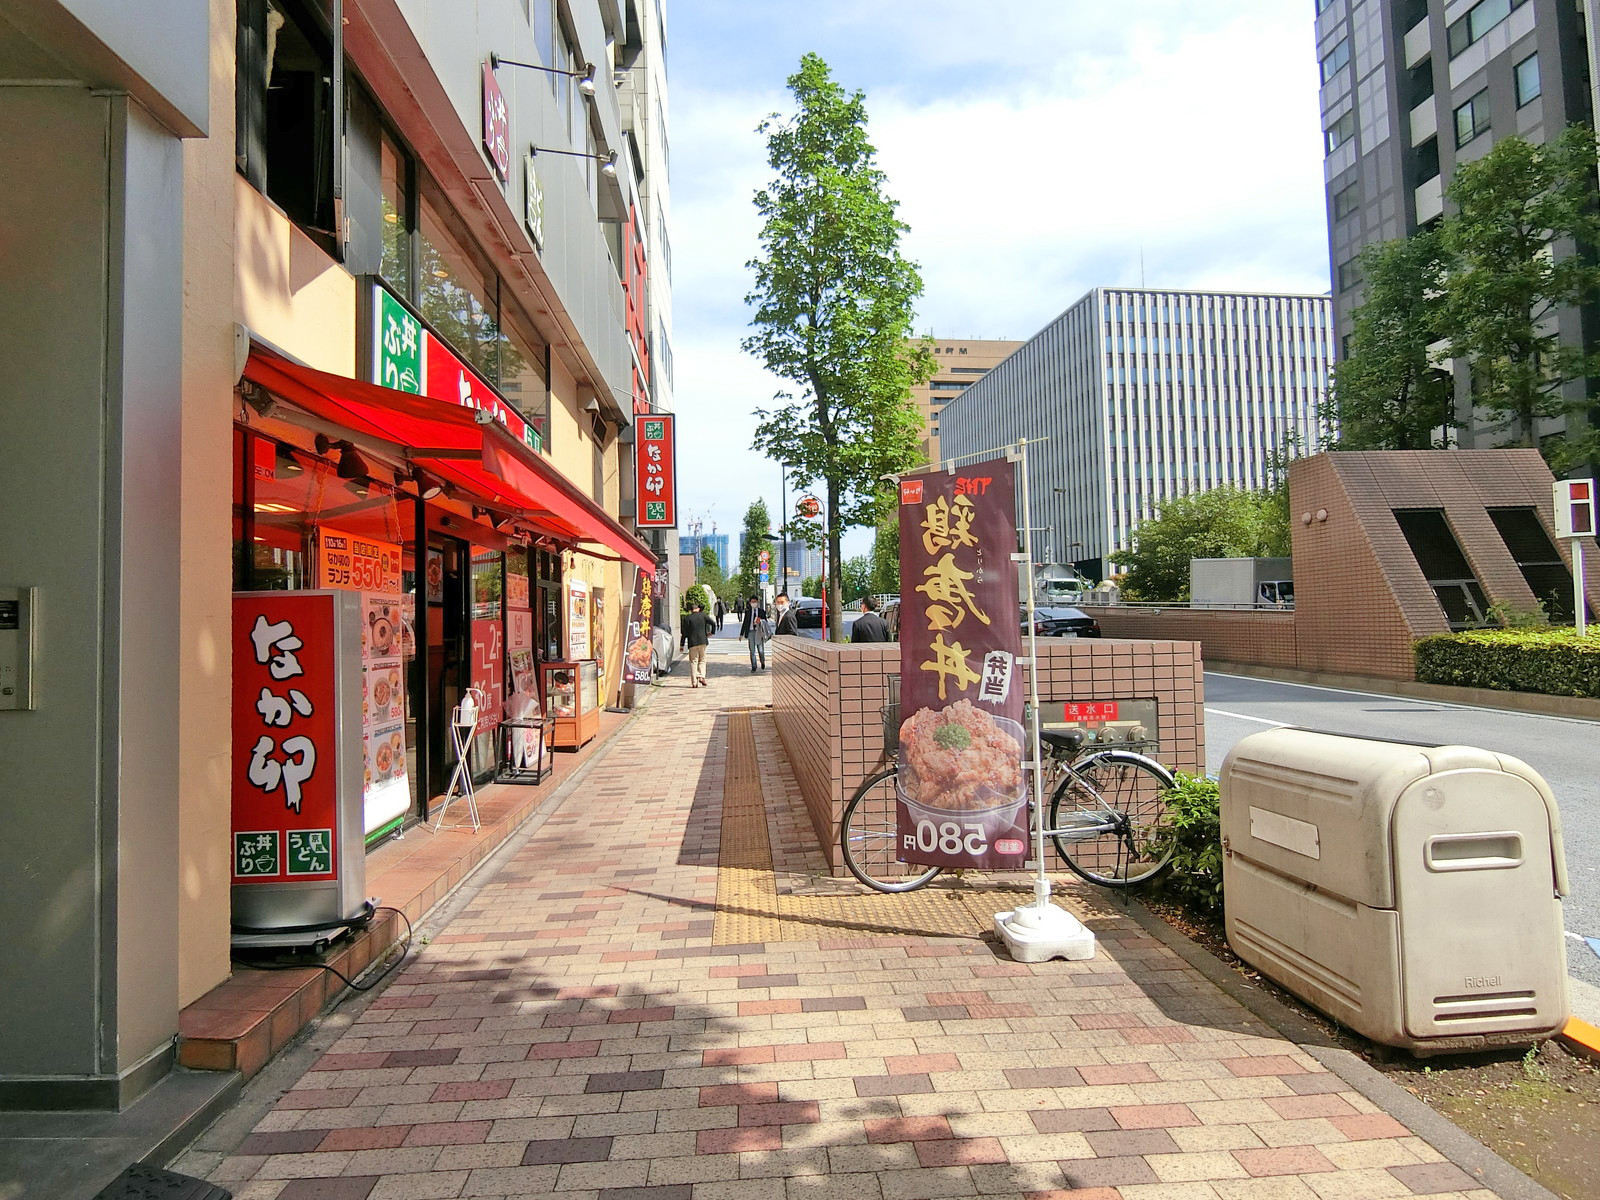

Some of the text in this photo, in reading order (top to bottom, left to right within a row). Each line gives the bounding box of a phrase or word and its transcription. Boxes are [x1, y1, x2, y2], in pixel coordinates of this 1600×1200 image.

[645, 444, 664, 497] なか卯
[327, 568, 350, 585] ランチ
[248, 614, 317, 814] なか卯
[1068, 703, 1114, 715] 送水口
[240, 834, 273, 873] 丼ぶり
[289, 833, 325, 871] うどん
[1464, 975, 1502, 989] Richell
